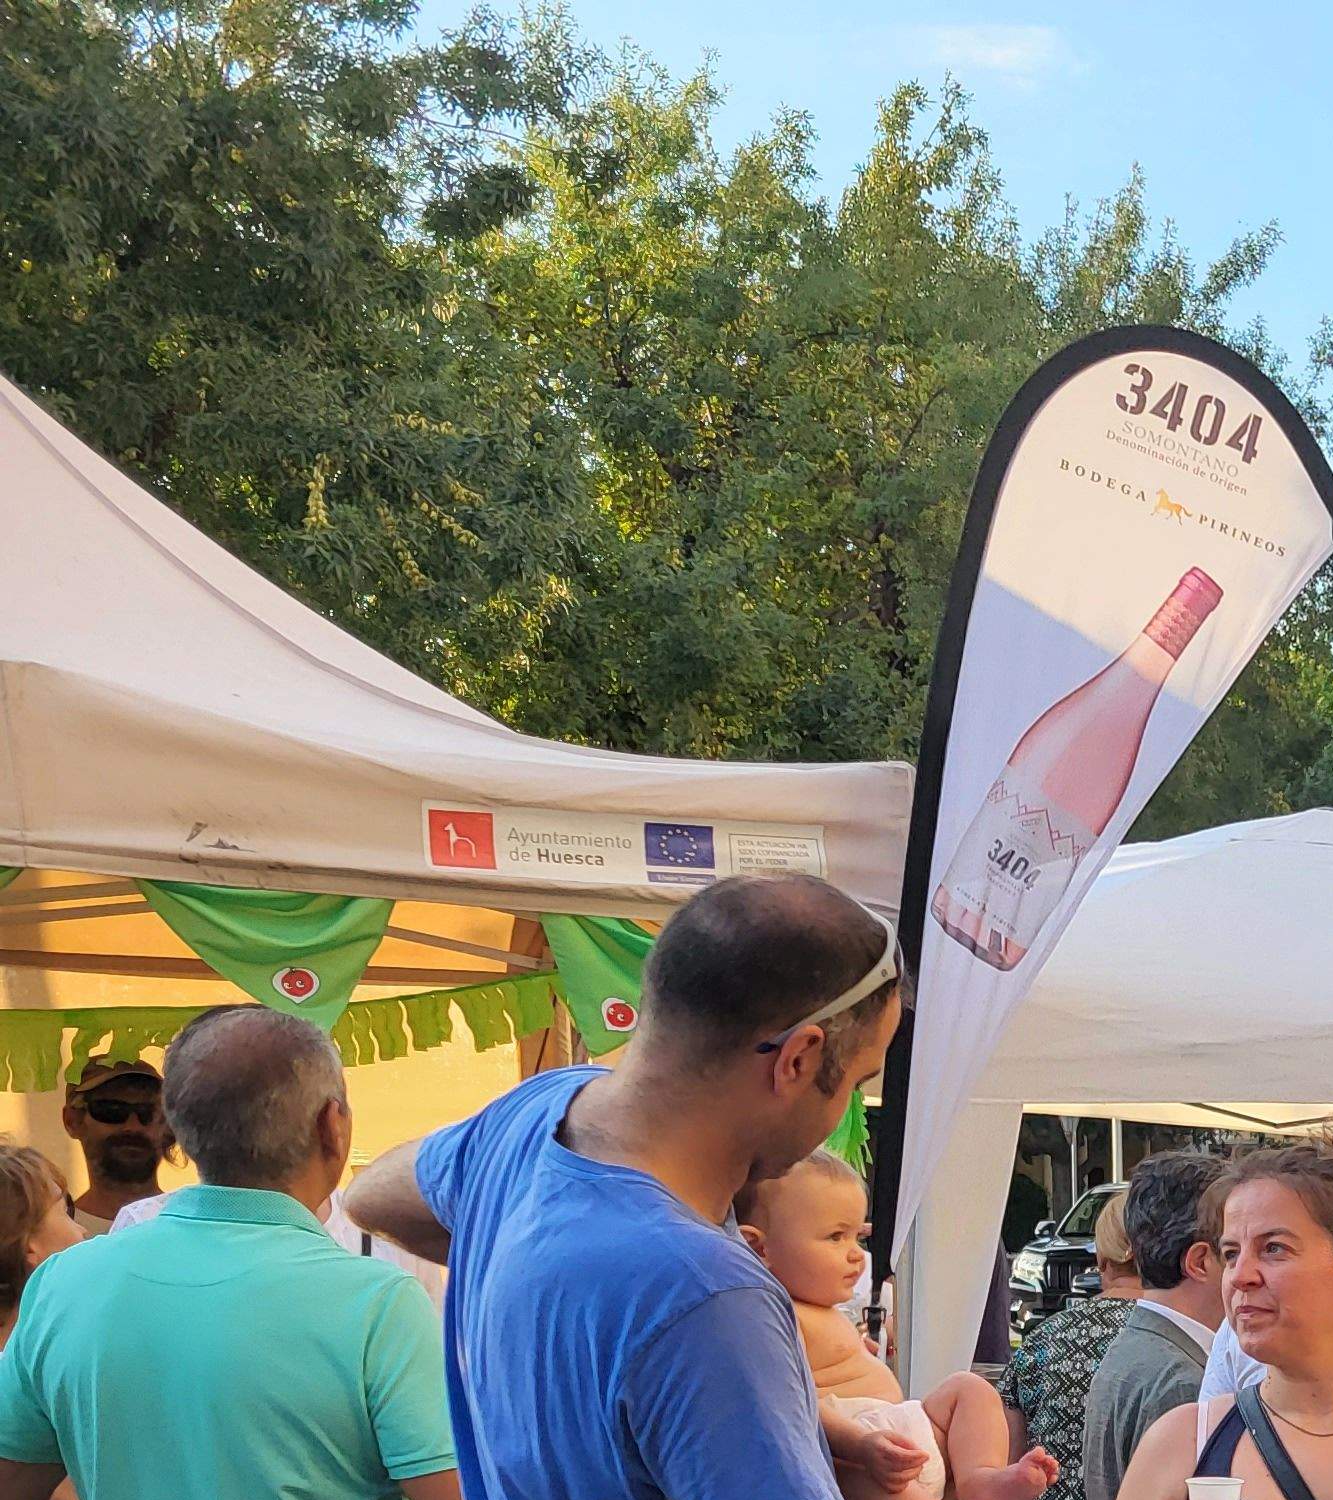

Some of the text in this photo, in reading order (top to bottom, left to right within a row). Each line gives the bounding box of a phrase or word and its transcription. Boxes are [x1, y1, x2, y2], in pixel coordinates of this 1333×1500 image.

[1115, 363, 1263, 465] 3404
[1106, 429, 1249, 496] Denominación de Origen
[1121, 421, 1240, 478] SOMONTANO
[1059, 459, 1288, 557] BODEGA PIRINEOS
[507, 827, 632, 850] Ayuntamiento
[509, 848, 605, 867] de Huesca
[987, 838, 1042, 892] 3404
